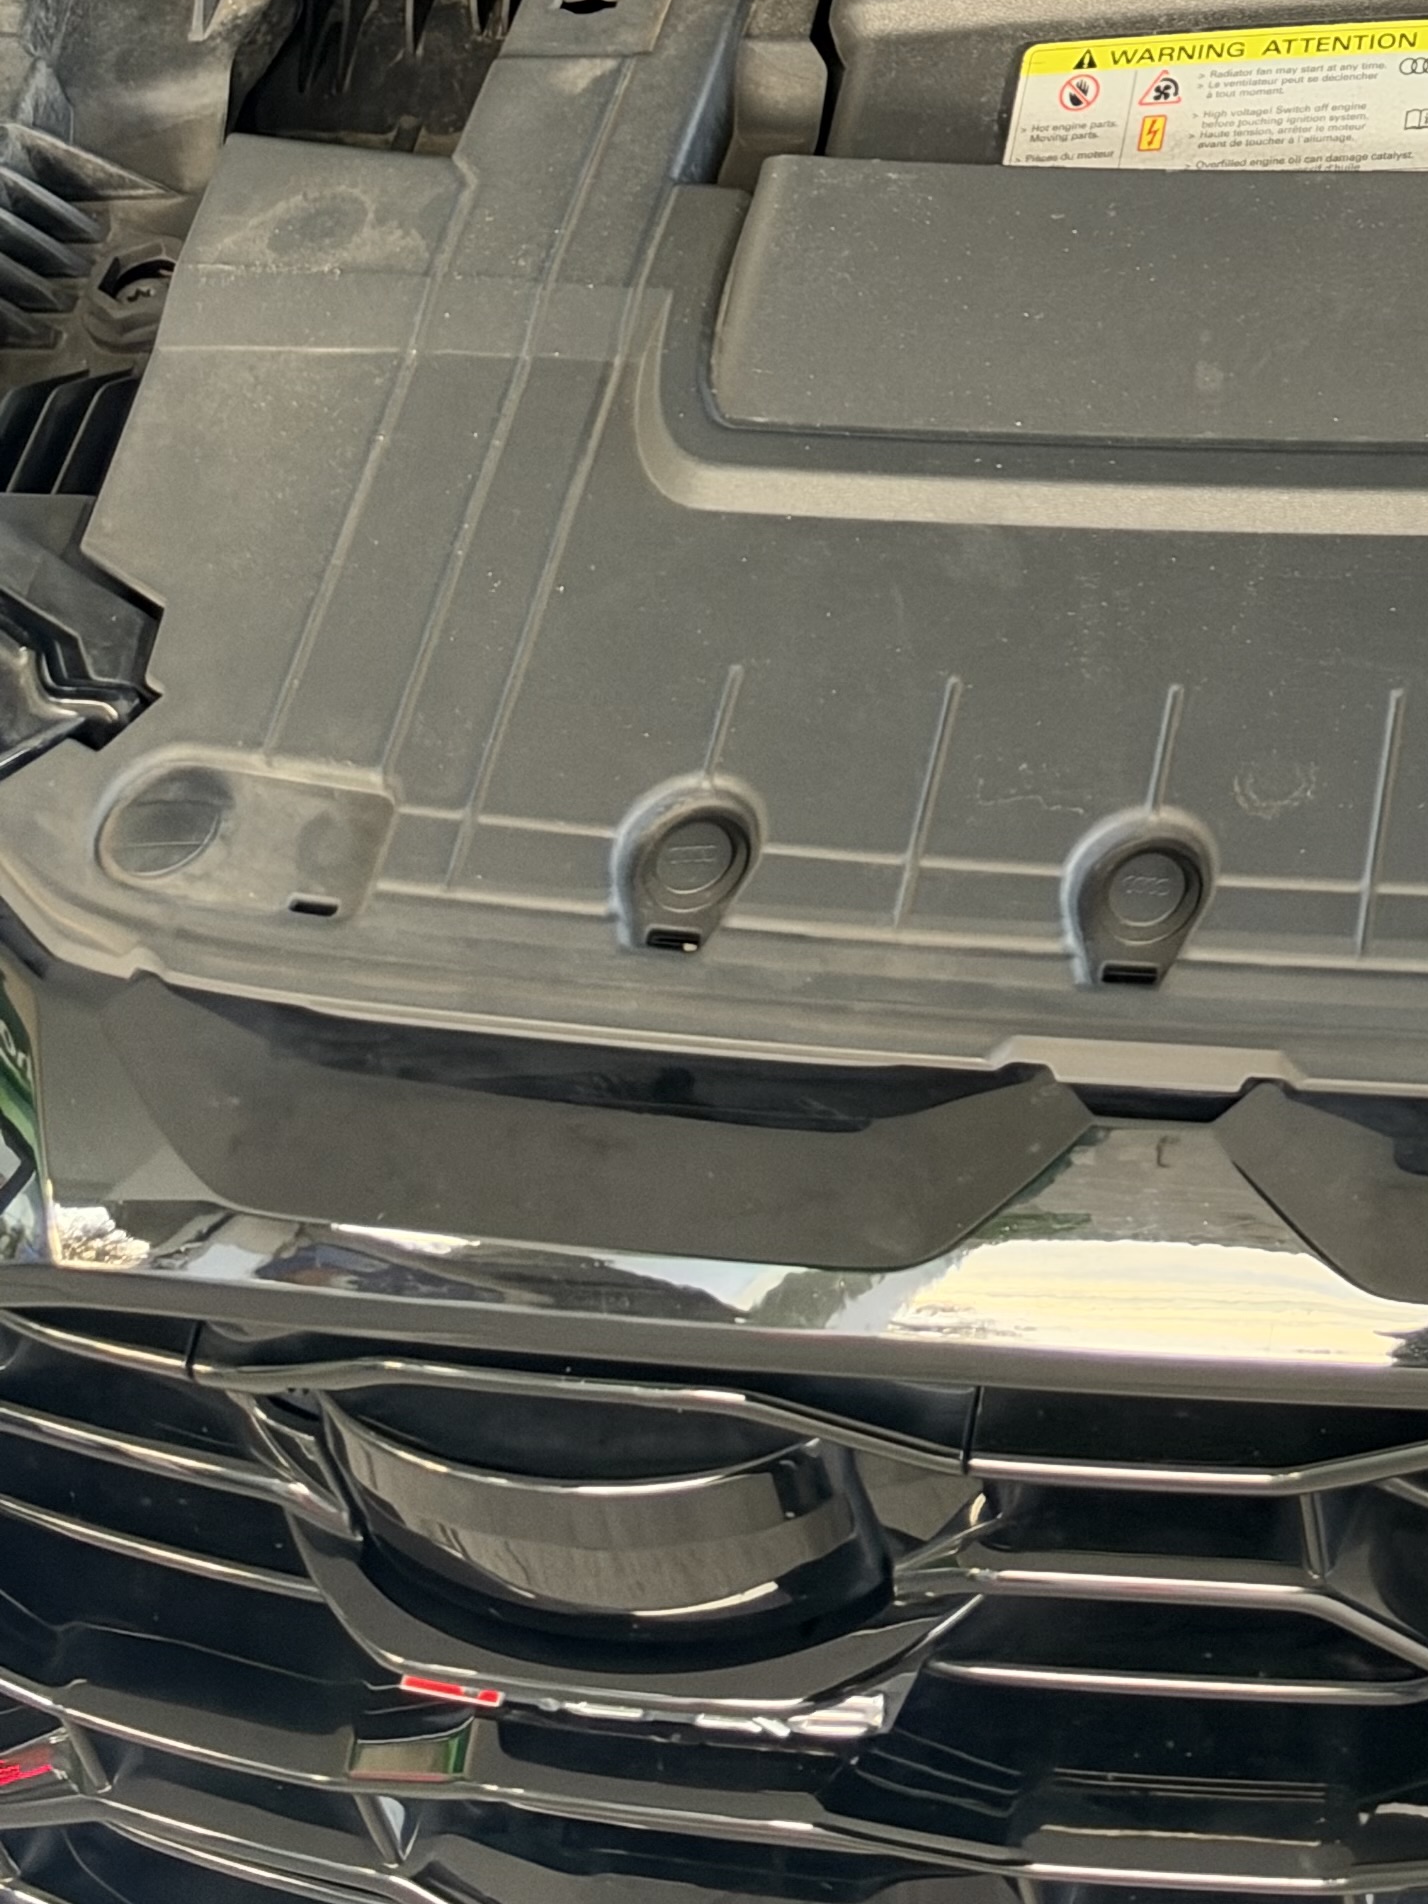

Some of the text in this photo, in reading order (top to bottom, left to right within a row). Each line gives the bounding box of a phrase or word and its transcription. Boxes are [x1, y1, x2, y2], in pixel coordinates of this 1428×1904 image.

[1111, 32, 1418, 65] WARNING ATTENTION
[1210, 67, 1253, 79] Radiator
[1256, 67, 1273, 76] fan
[1276, 66, 1298, 75] may
[1301, 64, 1324, 73] start
[1340, 64, 1358, 72] any
[1362, 61, 1387, 70] time.
[1208, 80, 1220, 89] Le
[1224, 77, 1277, 87] ventilateur
[1281, 76, 1304, 86] peut
[1216, 89, 1236, 98] tout
[1239, 87, 1284, 96] moment.
[1203, 102, 1367, 120] High voltage! Switch off engine
[1032, 124, 1049, 133] Hot
[1052, 122, 1087, 132] engine
[1201, 112, 1369, 129] before touching ignition system.
[1199, 129, 1230, 138] Haute
[1234, 127, 1274, 137] tension,
[1316, 124, 1324, 132] le
[1328, 122, 1366, 131] moteur
[1029, 133, 1068, 143] Moving
[1197, 140, 1227, 149] avant
[1229, 139, 1242, 148] de
[1245, 137, 1285, 147] toucher
[1060, 152, 1074, 161] du
[1077, 150, 1114, 159] moteur
[1196, 151, 1415, 169] Overfilled engine oil can damage catalyst.
